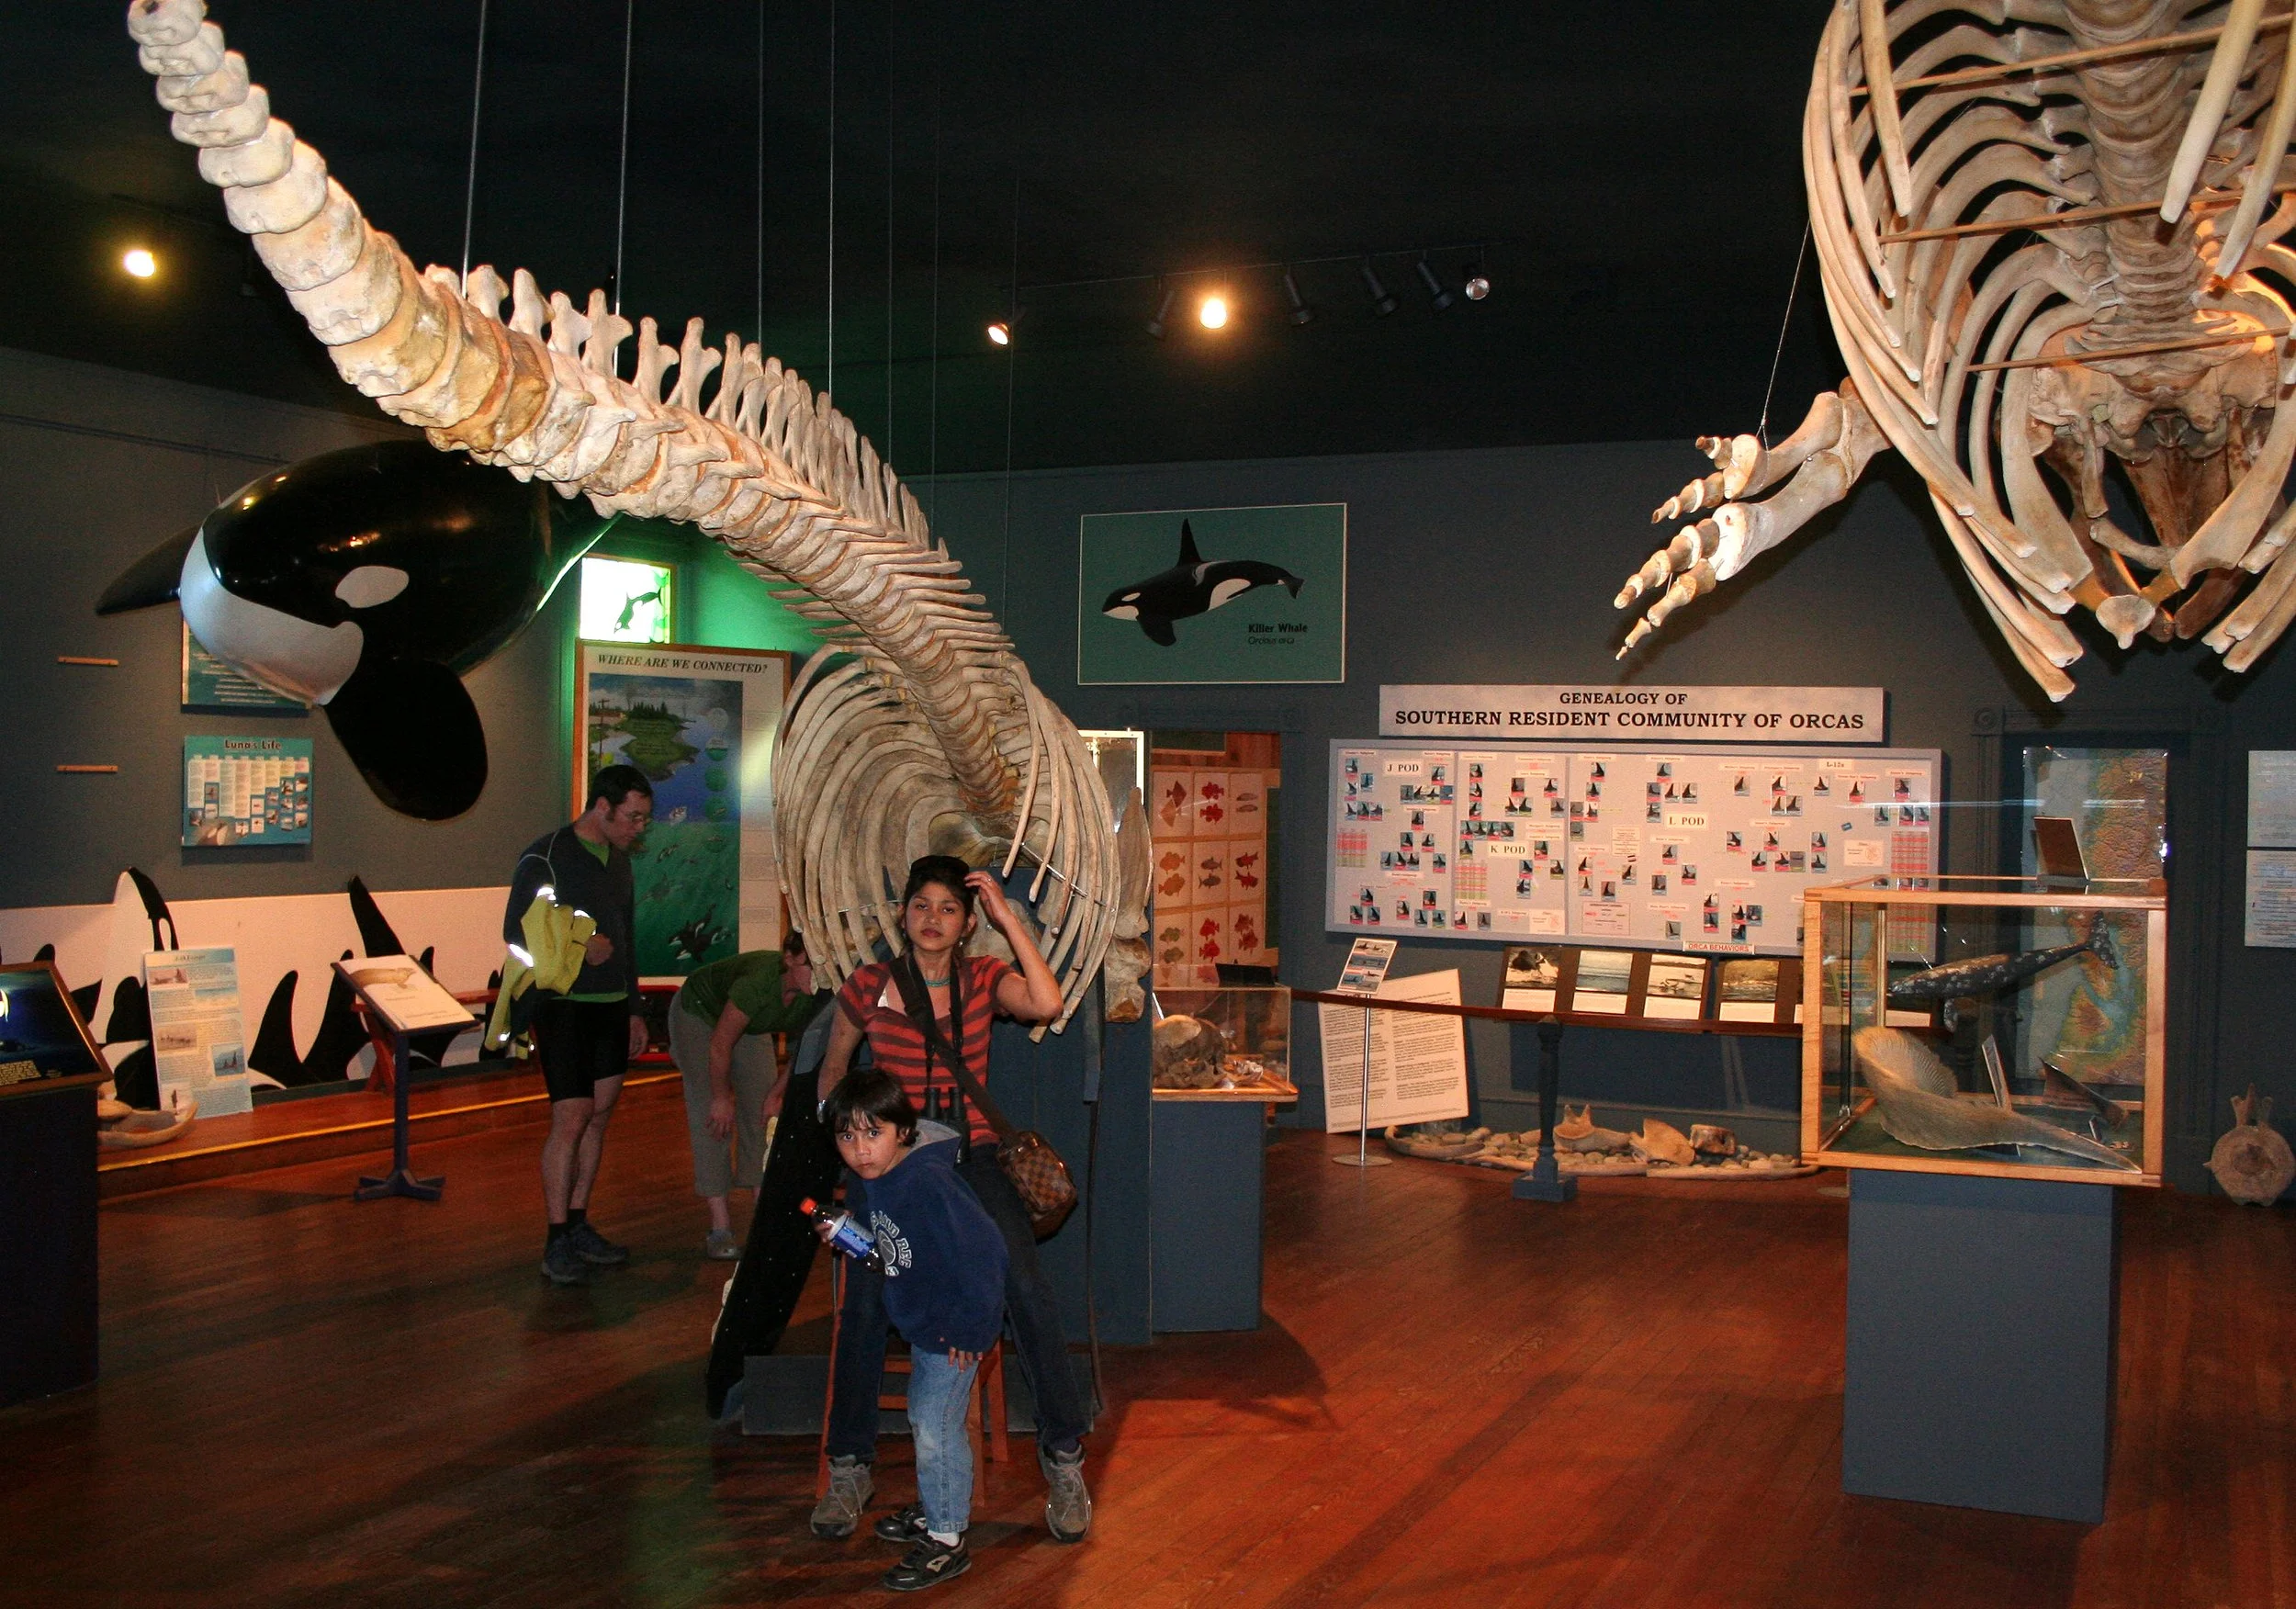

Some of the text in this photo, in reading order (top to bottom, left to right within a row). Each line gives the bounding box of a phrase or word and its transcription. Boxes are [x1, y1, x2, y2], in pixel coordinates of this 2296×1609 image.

[1248, 623, 1309, 633] Killer Whale
[598, 654, 769, 674] WHERE ARE WE CONNECTED?
[1559, 692, 1688, 705] GENEALOGY OF
[1395, 710, 1863, 729] SOUTHERN RESIDENT COMMUNITY OF ORCAS
[224, 738, 282, 750] Luna's Life
[1387, 763, 1420, 772] J POD
[1669, 816, 1705, 826] L POD
[1491, 845, 1525, 855] K POD
[1687, 942, 1750, 952] ORCA BEHAVIORS
